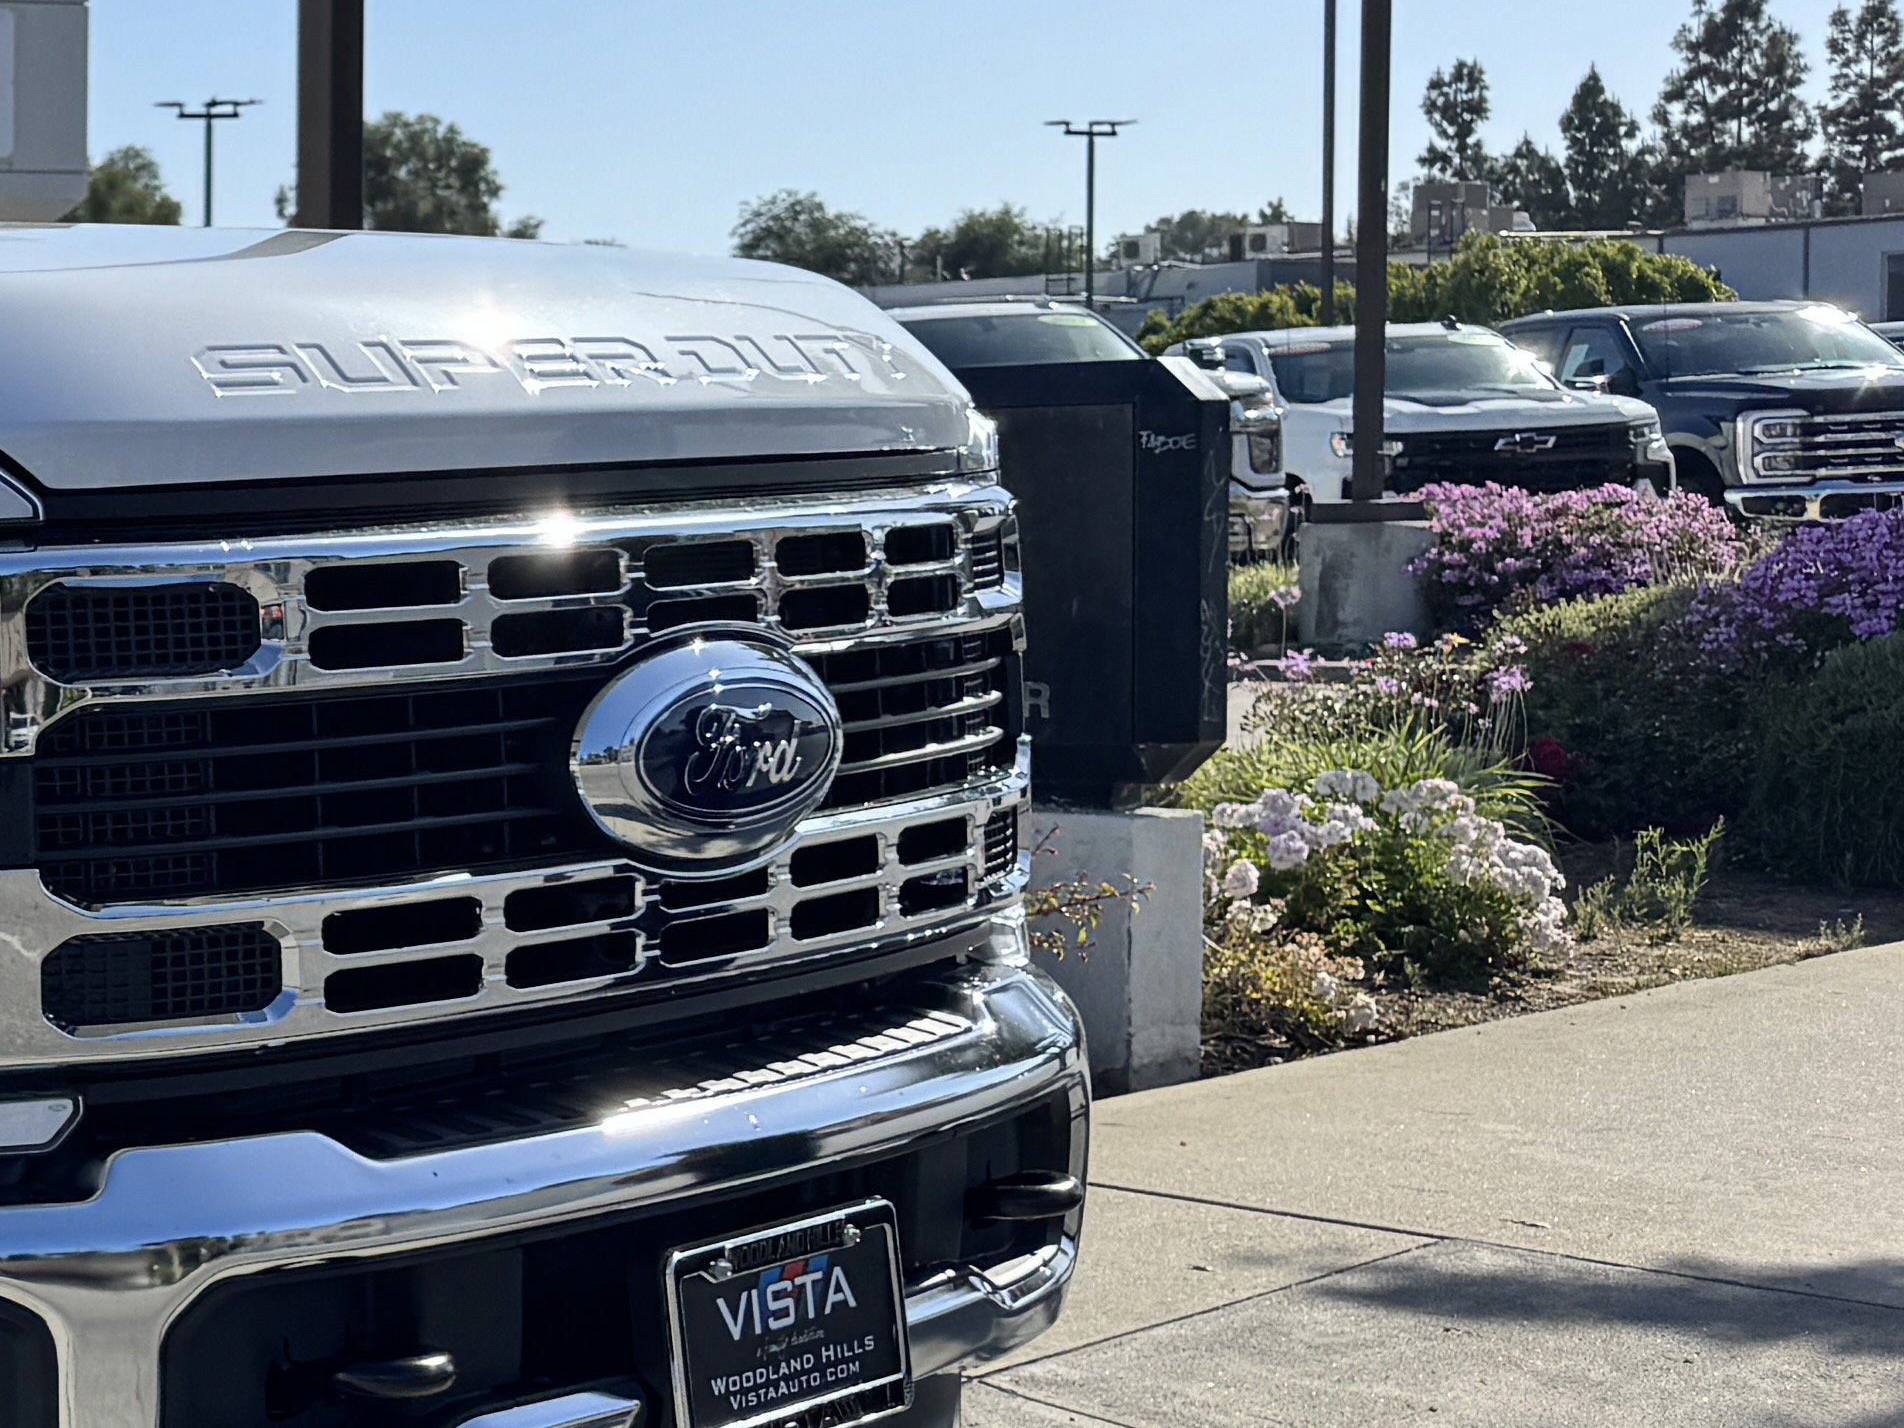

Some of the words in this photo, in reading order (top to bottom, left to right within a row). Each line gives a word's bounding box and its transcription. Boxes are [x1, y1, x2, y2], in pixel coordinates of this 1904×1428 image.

[191, 336, 678, 396] SUPER
[664, 334, 907, 385] DUTY
[684, 702, 803, 797] Ford
[716, 1266, 858, 1342] VISTA
[711, 1354, 815, 1396] WOODLAND
[821, 1335, 875, 1363] HILLS
